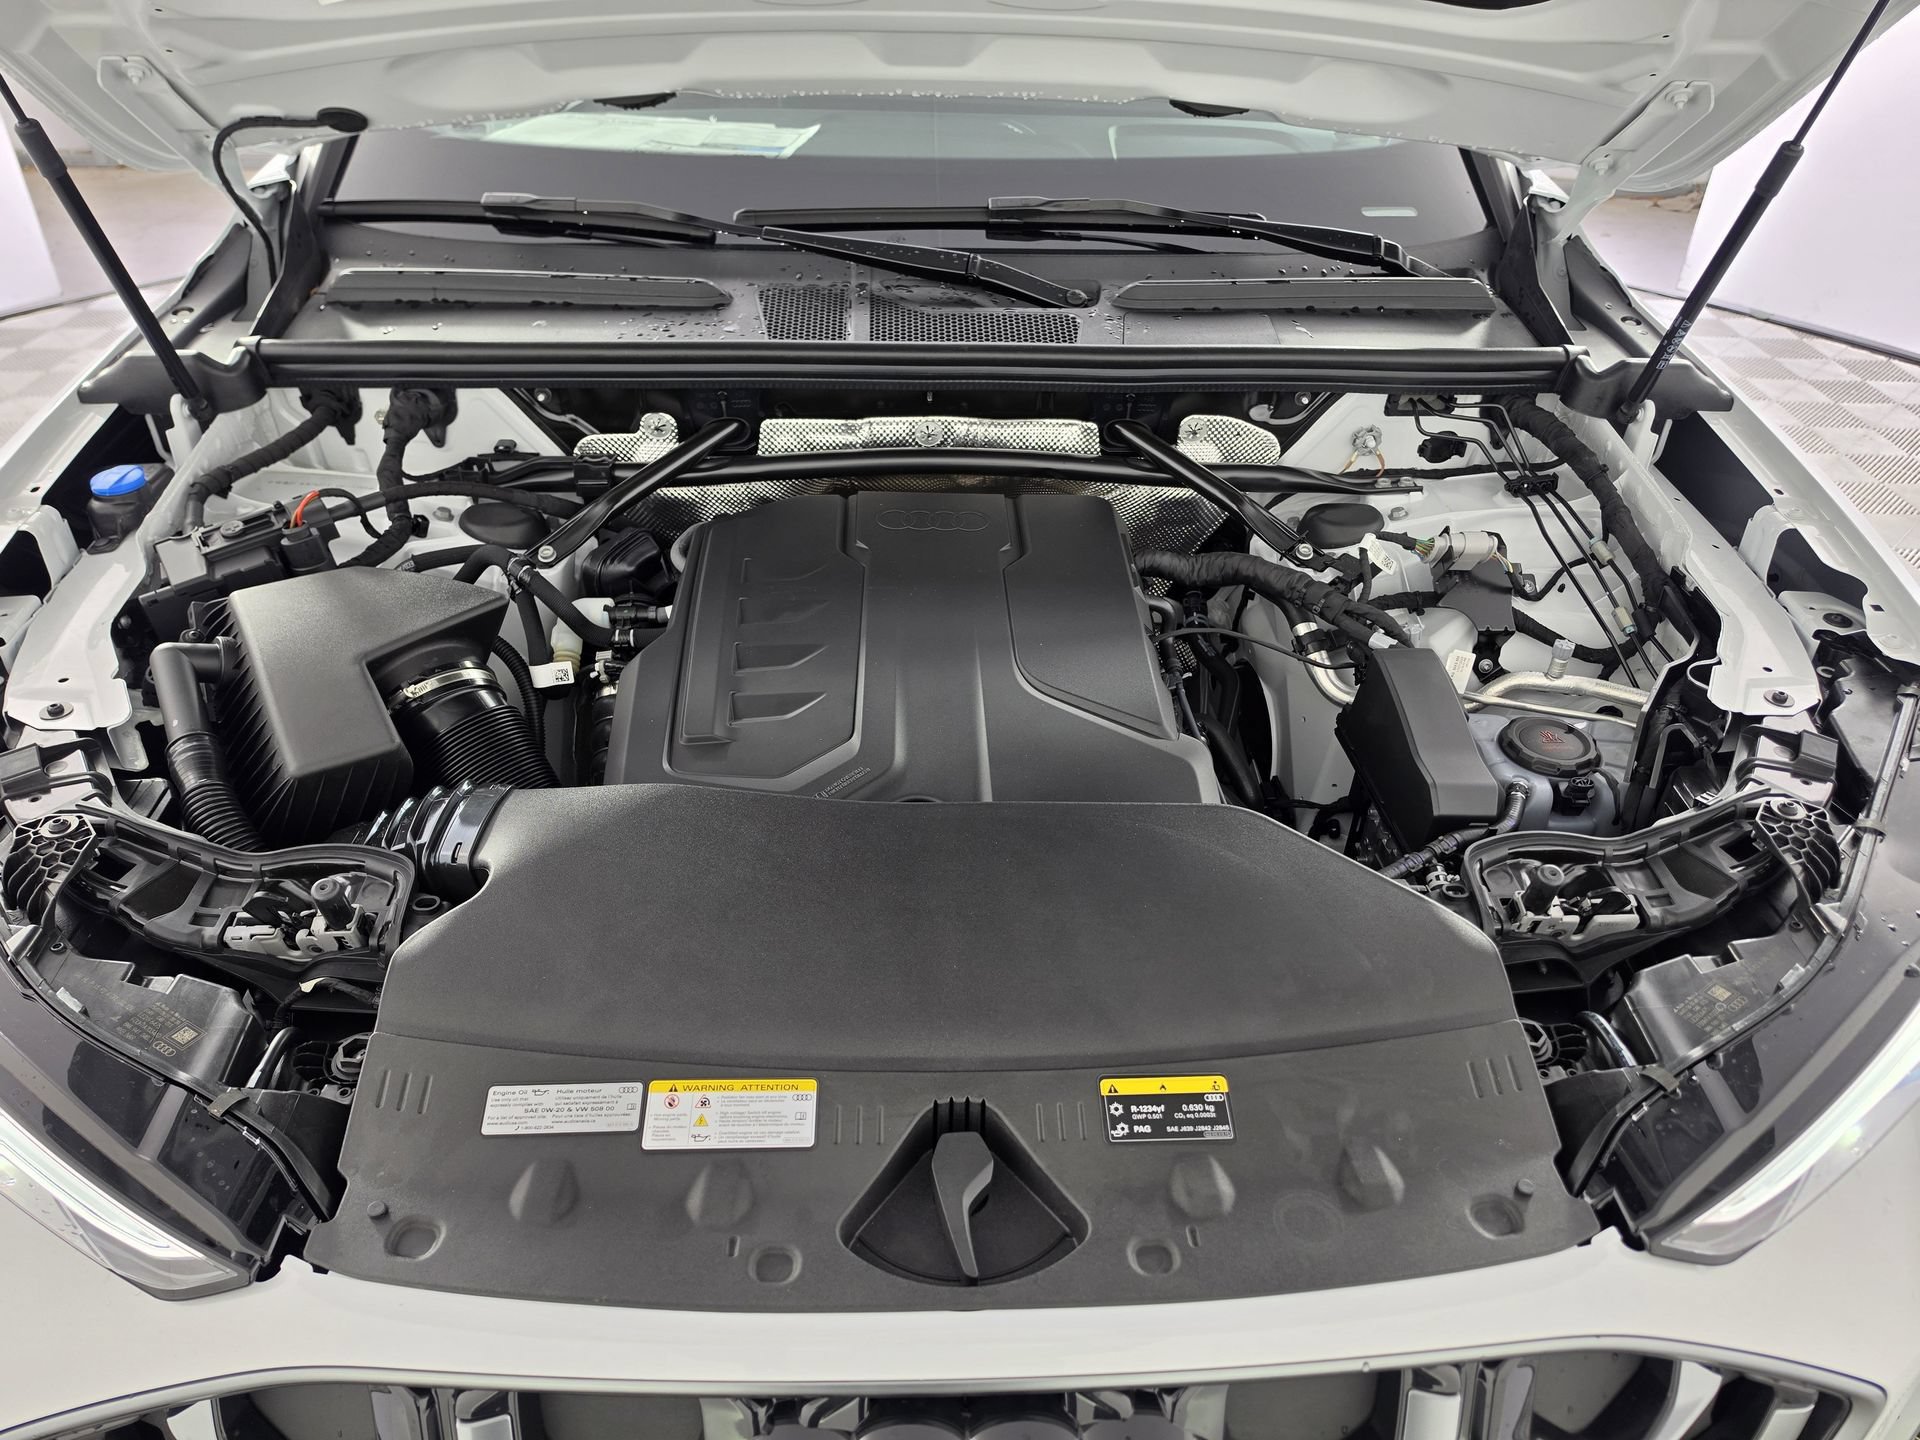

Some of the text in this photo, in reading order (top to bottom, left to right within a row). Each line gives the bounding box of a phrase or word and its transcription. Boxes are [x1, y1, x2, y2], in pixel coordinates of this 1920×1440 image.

[1130, 1105, 1165, 1113] R-1234yf
[1205, 1104, 1215, 1112] kg
[1133, 1125, 1152, 1133] PAG
